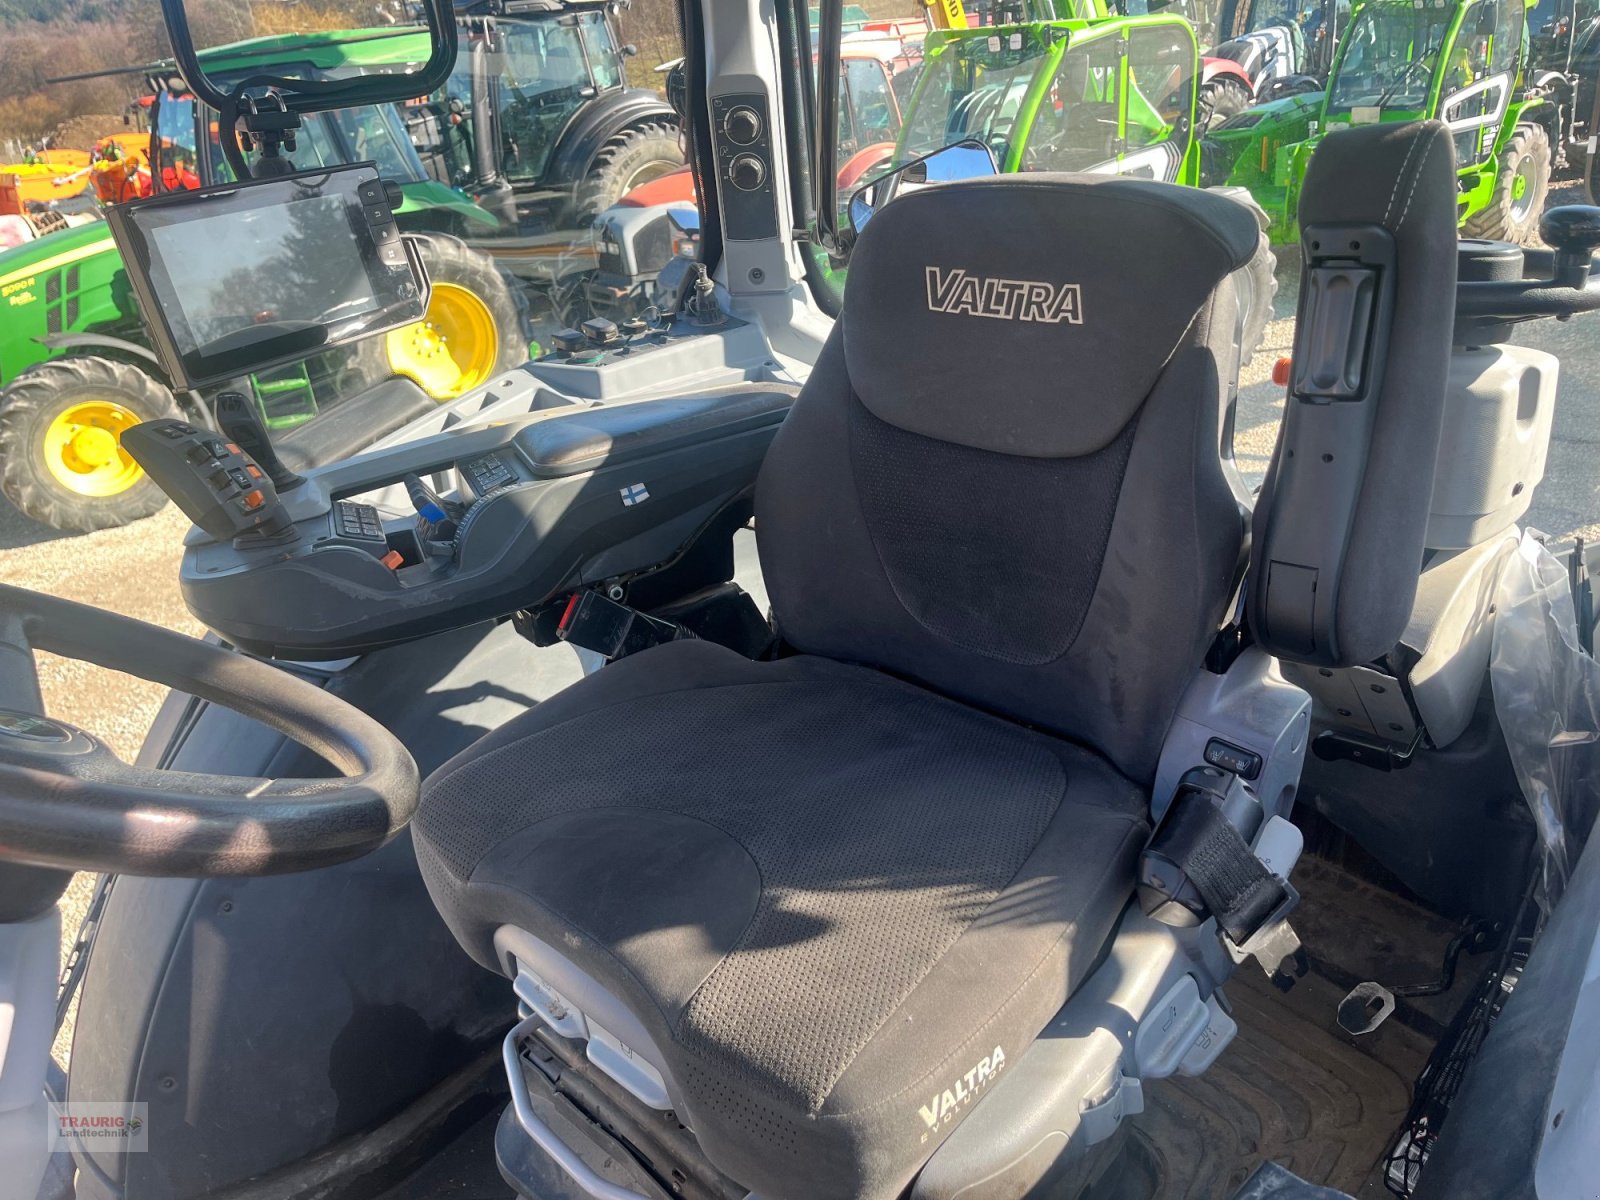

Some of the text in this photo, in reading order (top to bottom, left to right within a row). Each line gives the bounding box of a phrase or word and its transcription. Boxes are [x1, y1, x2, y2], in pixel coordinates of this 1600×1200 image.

[926, 266, 1083, 325] VALTRA
[918, 1045, 1005, 1128] VALTRA
[920, 1061, 1005, 1144] EVOLUTION
